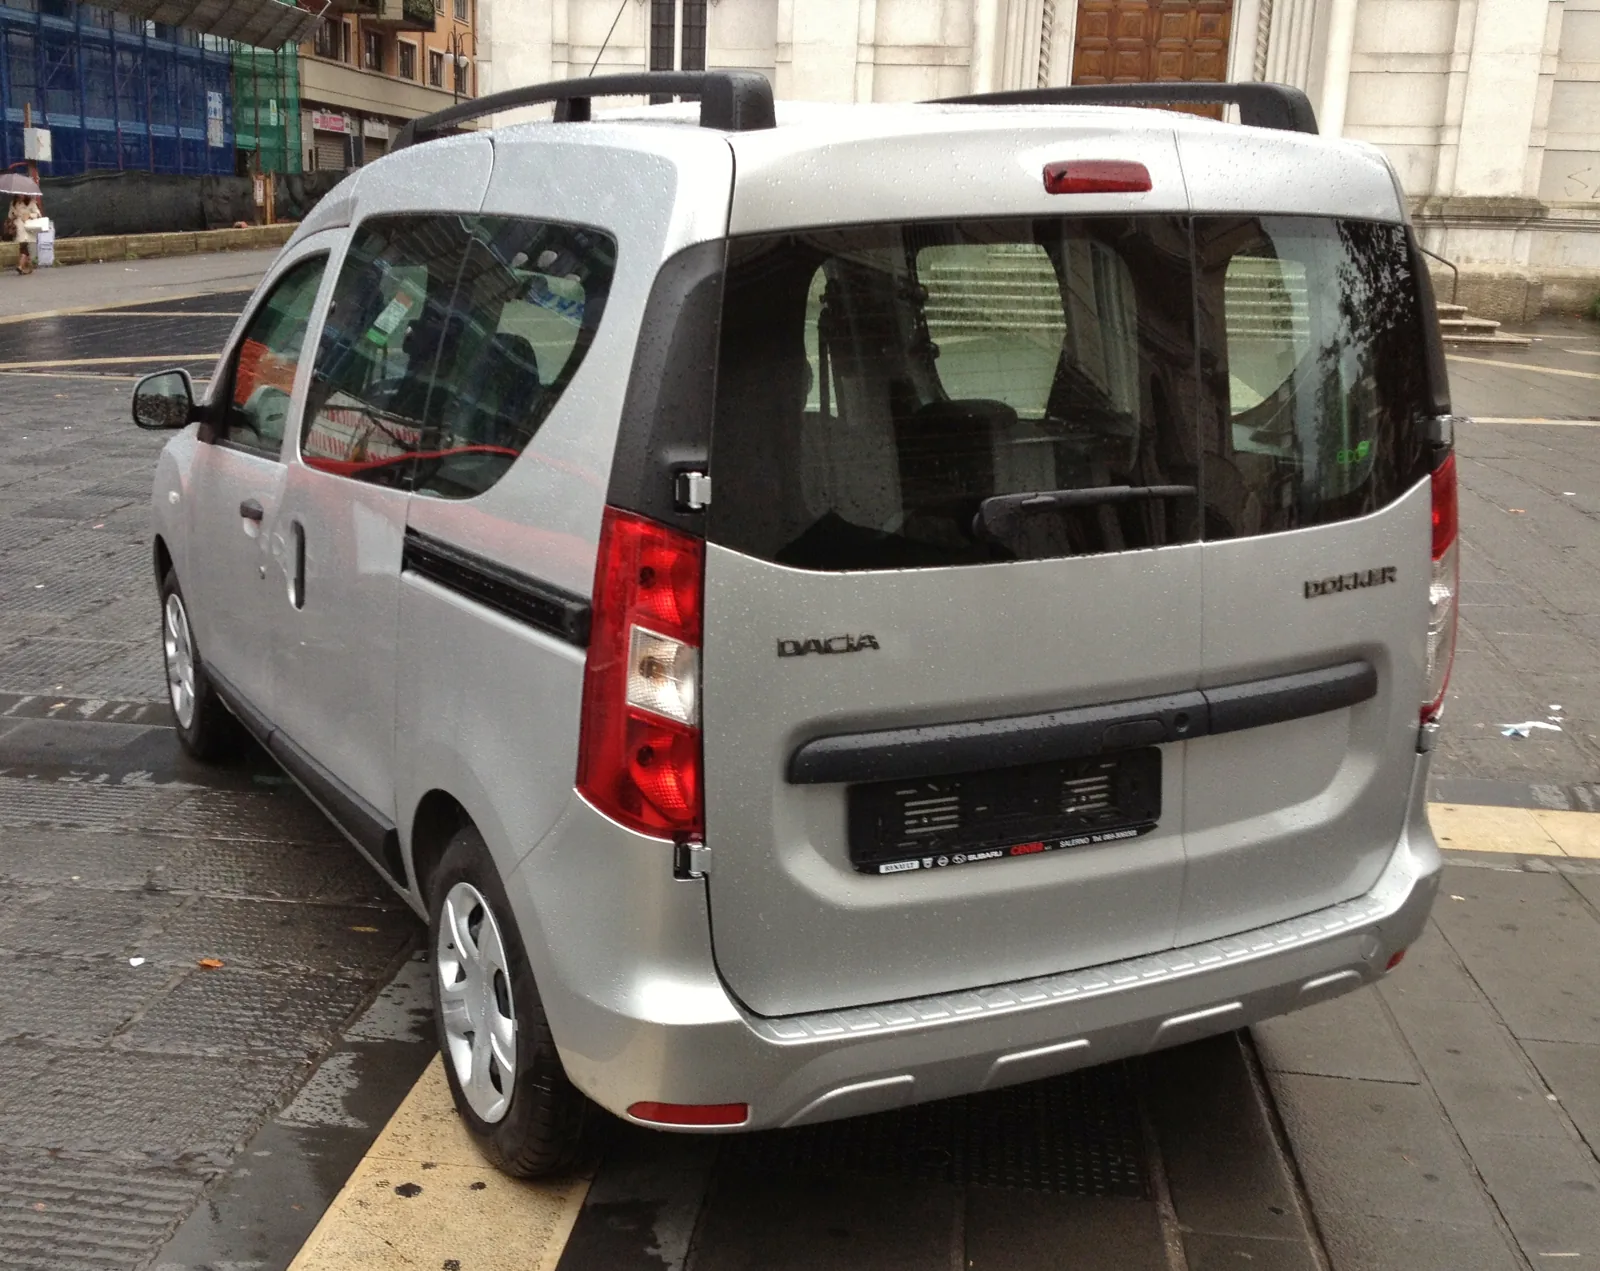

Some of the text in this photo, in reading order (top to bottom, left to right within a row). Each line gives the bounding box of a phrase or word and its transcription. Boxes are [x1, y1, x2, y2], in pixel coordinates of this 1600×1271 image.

[777, 634, 880, 658] DACIA
[967, 850, 1003, 861] SUBARU
[1060, 837, 1090, 848] SALERNO
